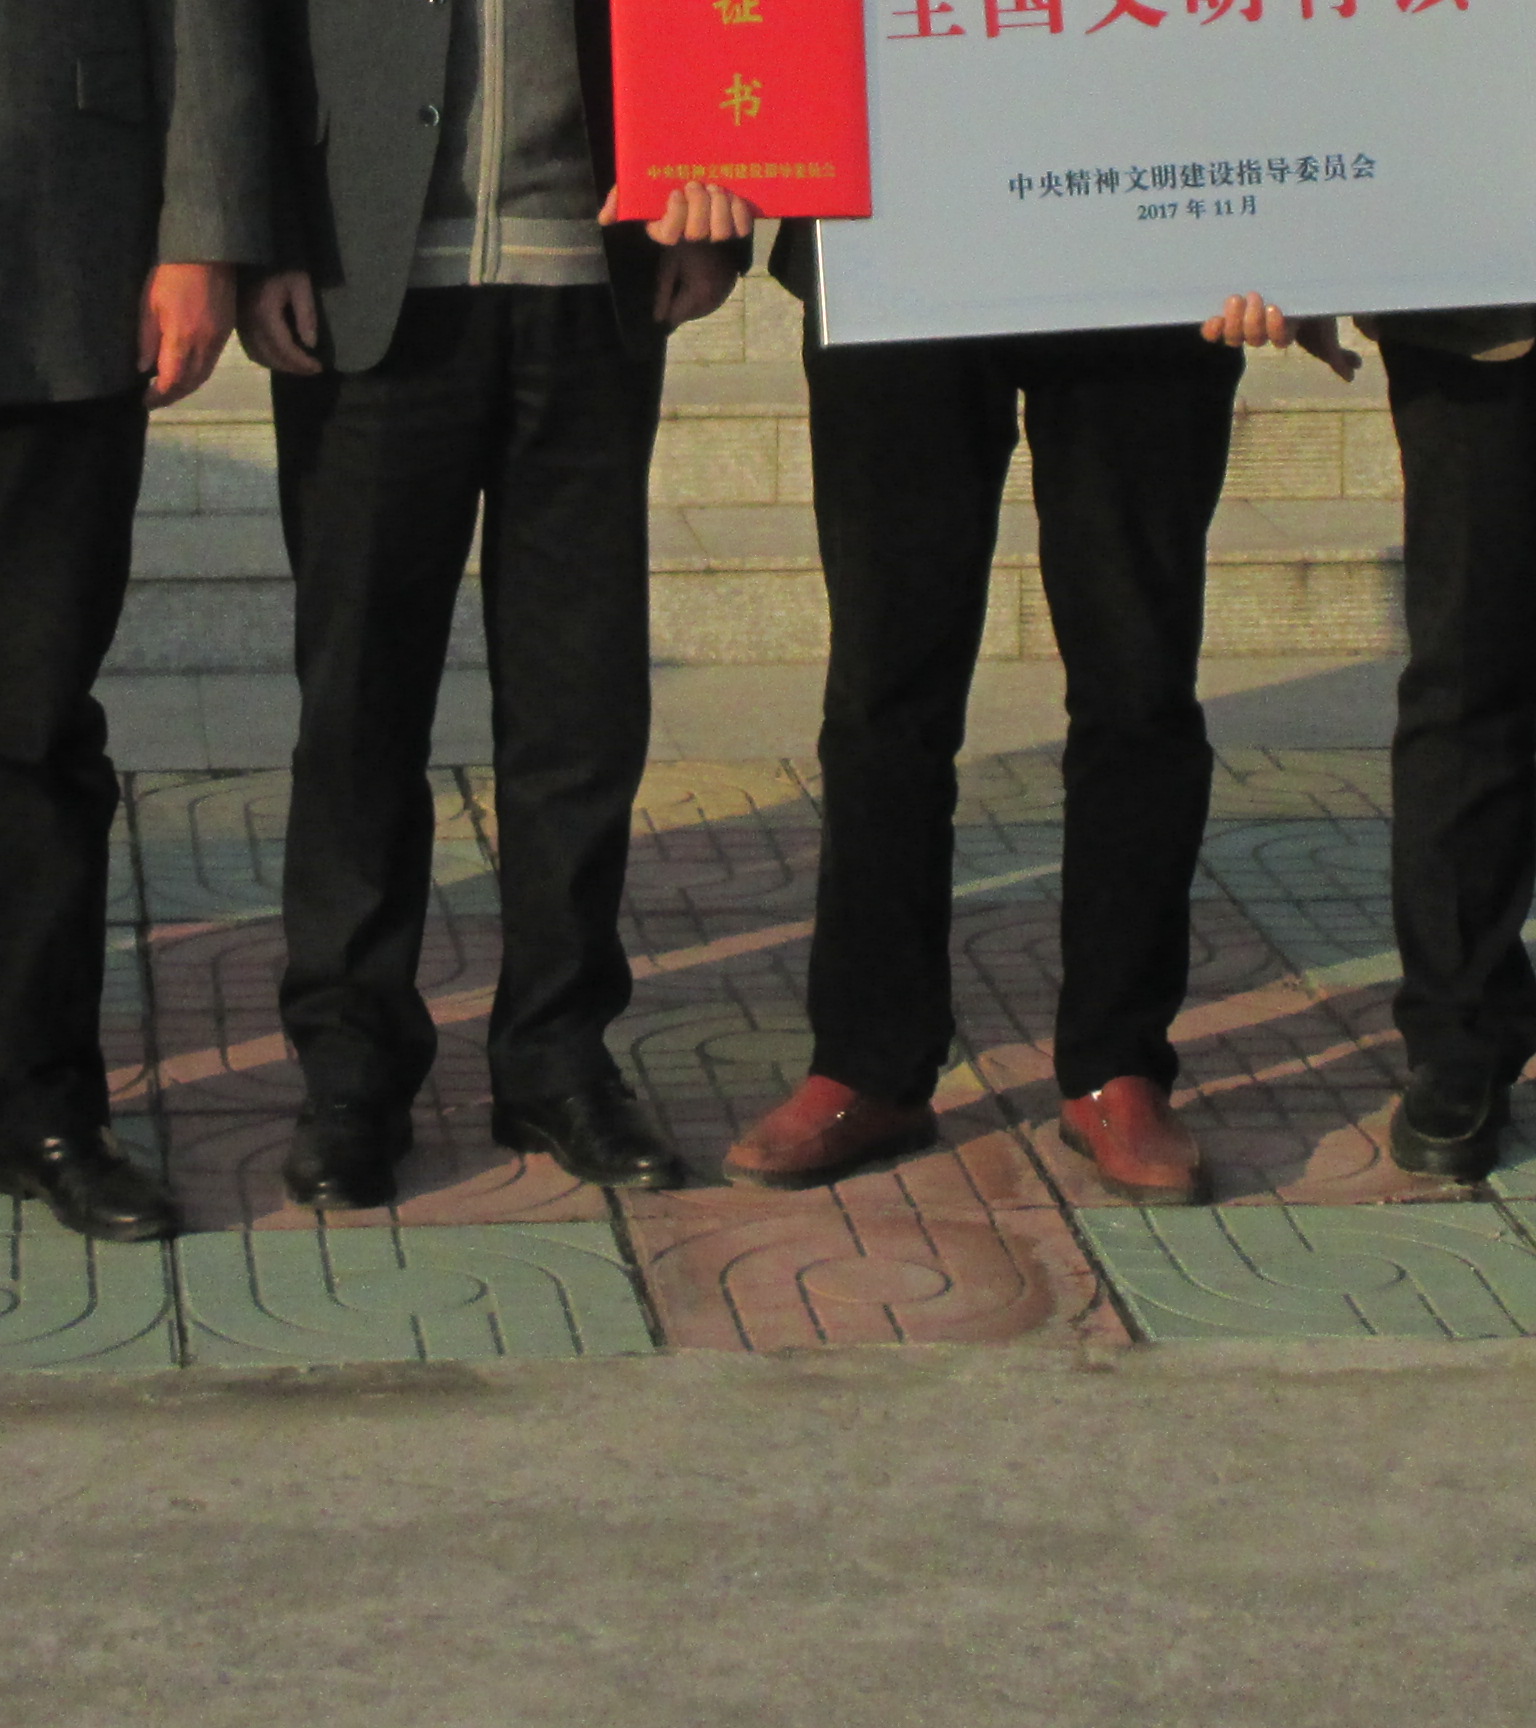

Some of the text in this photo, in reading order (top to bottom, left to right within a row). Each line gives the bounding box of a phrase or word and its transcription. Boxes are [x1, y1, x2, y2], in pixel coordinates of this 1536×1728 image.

[1008, 152, 1377, 200] 中央精神文明建设指导委员会
